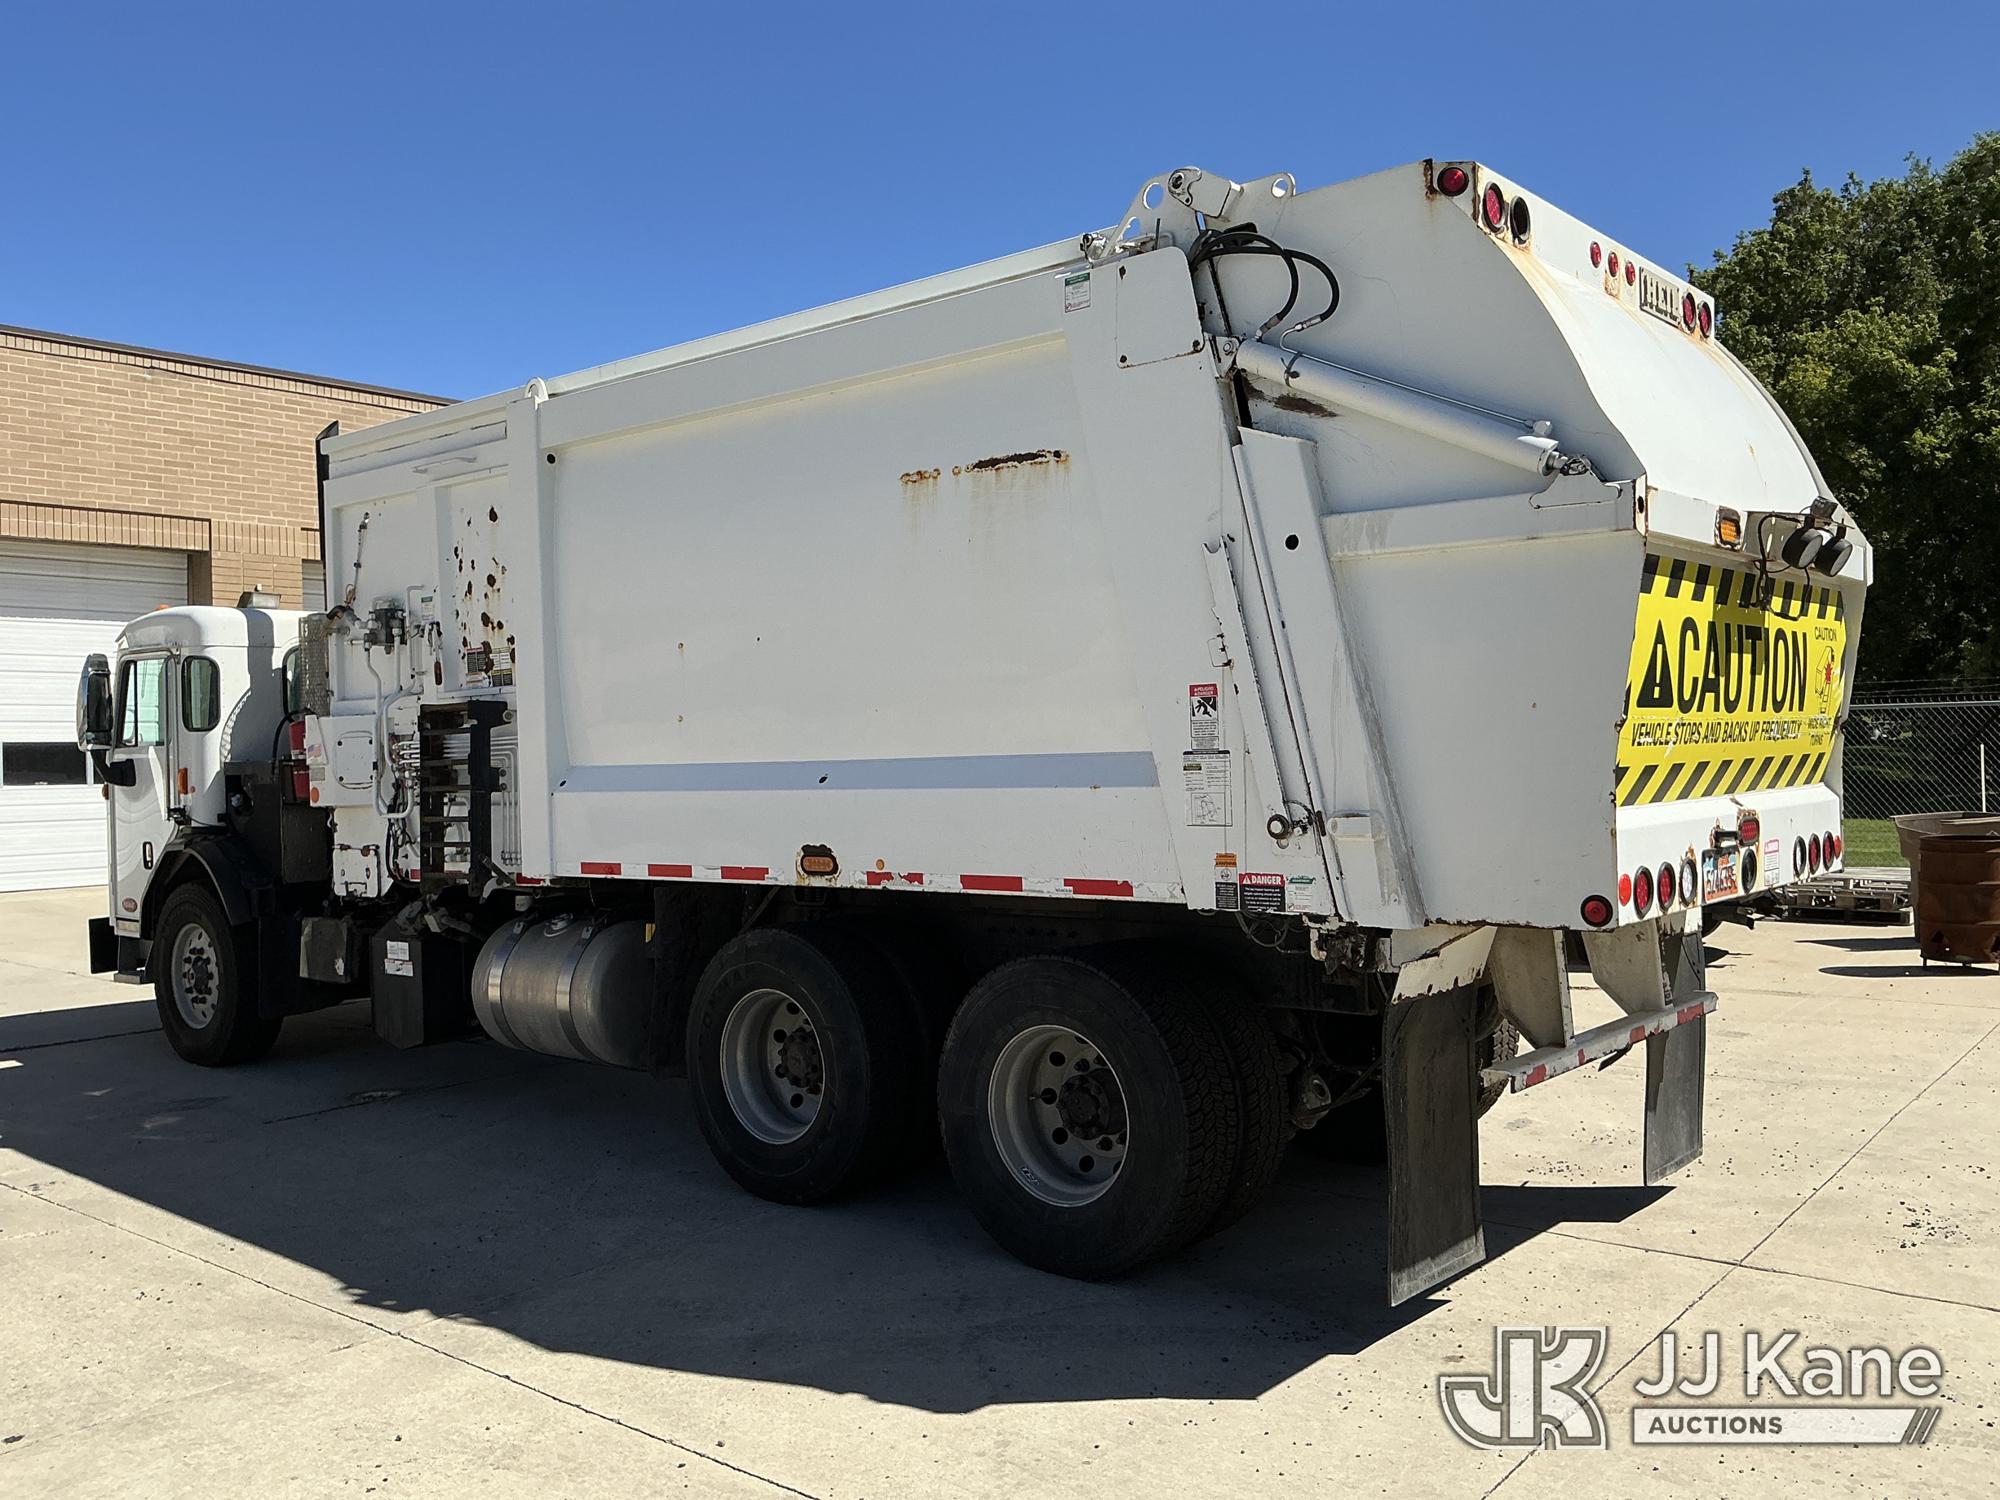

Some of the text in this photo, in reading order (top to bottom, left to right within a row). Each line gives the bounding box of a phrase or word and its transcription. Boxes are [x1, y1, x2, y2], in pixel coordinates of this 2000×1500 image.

[1814, 625, 1838, 642] CAUTION
[1677, 616, 1807, 714] CAUTION
[1631, 722, 1673, 747] VEHICLE
[1673, 721, 1703, 746] STOPS
[1702, 721, 1722, 744] AND
[1721, 720, 1749, 743] BACKS
[1748, 720, 1761, 742] UP
[1251, 874, 1282, 886] DANGER
